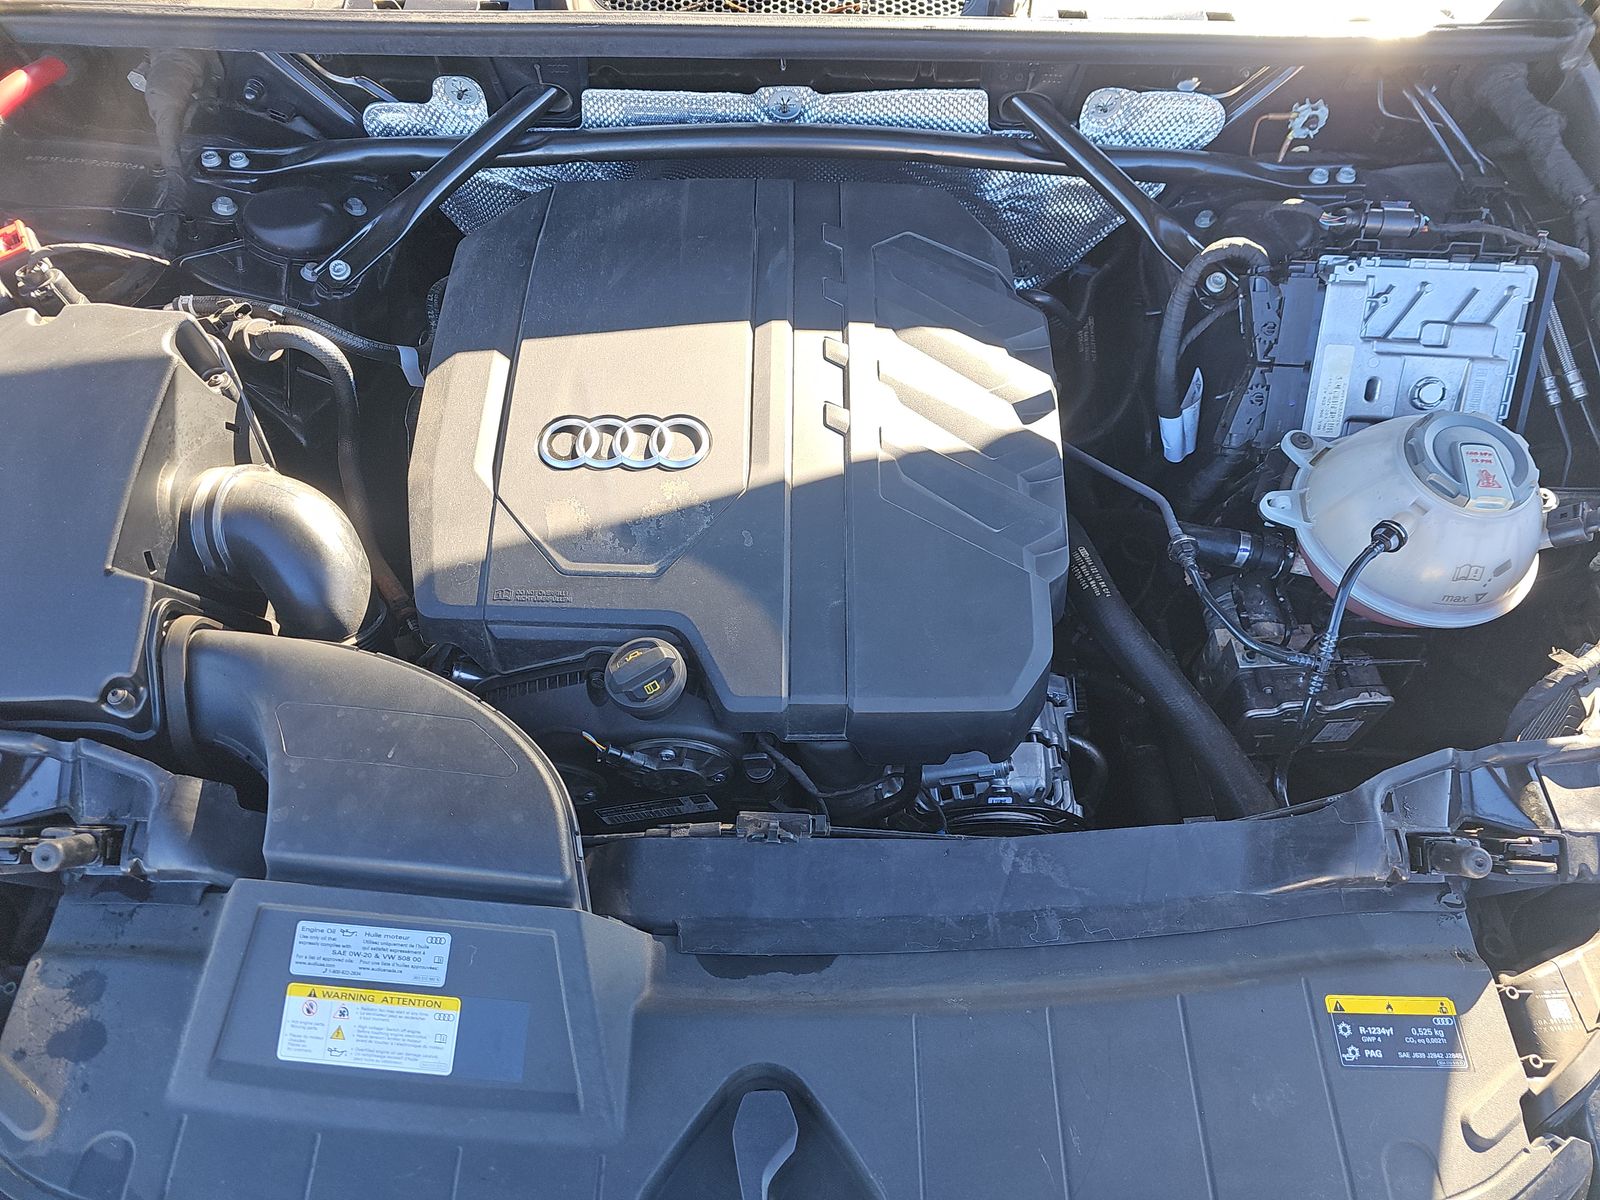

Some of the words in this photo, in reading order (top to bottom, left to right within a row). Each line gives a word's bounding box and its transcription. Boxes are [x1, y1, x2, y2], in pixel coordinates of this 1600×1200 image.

[1441, 594, 1469, 603] max
[321, 990, 375, 1002] WARNING
[381, 996, 442, 1008] ATTENTION
[1359, 1026, 1394, 1036] R-1234yf
[1411, 1028, 1432, 1036] 0,525
[1434, 1028, 1444, 1037] kg
